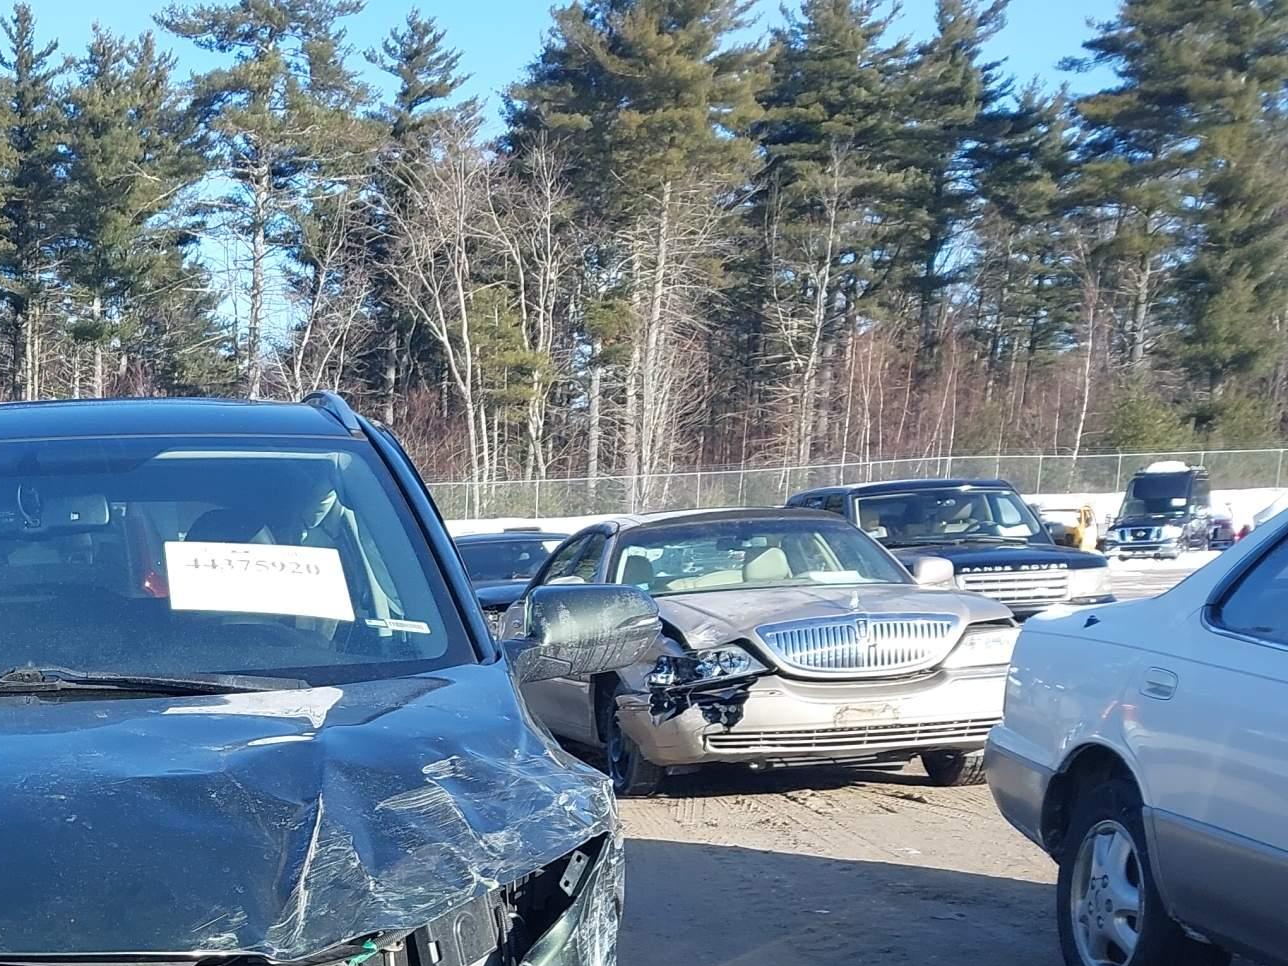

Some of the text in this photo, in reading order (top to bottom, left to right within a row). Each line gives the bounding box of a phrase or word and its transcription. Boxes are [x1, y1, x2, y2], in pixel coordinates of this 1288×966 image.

[184, 556, 321, 576] 44375920
[962, 563, 1068, 573] RANGE ROVER
